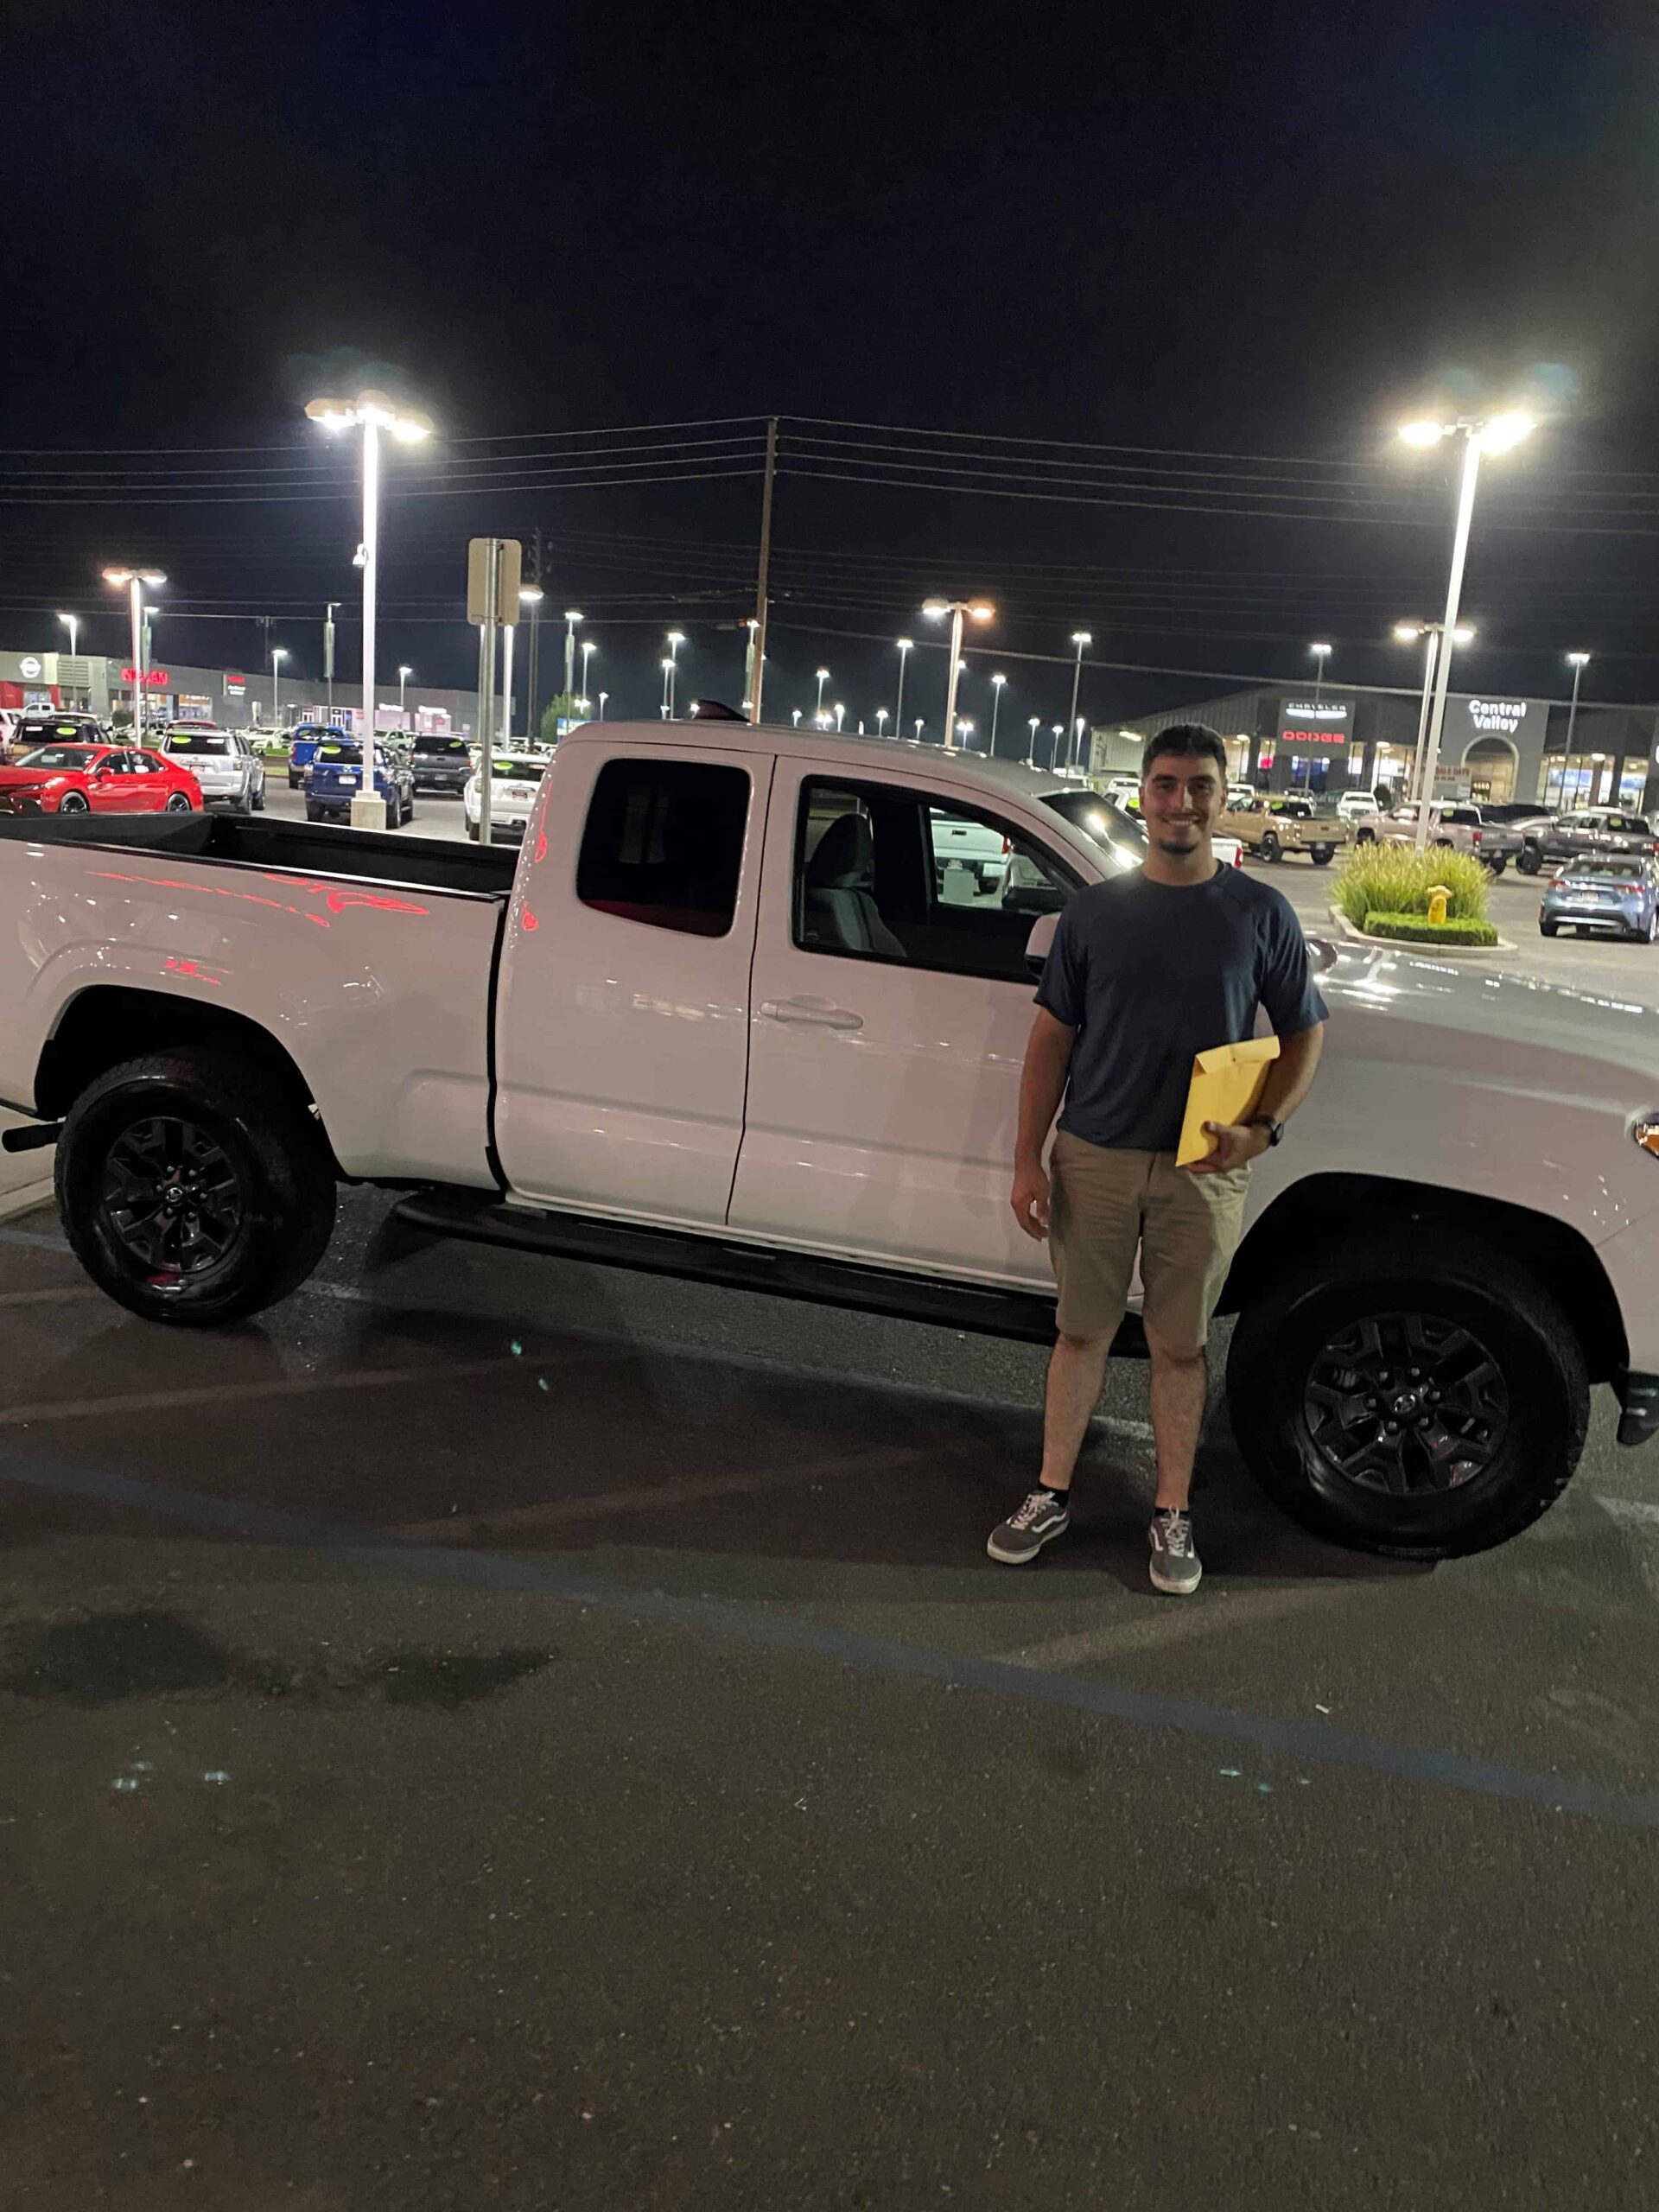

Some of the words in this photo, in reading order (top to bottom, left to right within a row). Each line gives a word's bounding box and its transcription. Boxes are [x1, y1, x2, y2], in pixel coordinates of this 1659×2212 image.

[1469, 699, 1527, 717] Central
[1473, 714, 1518, 734] Valley
[1283, 730, 1344, 744] DODGE
